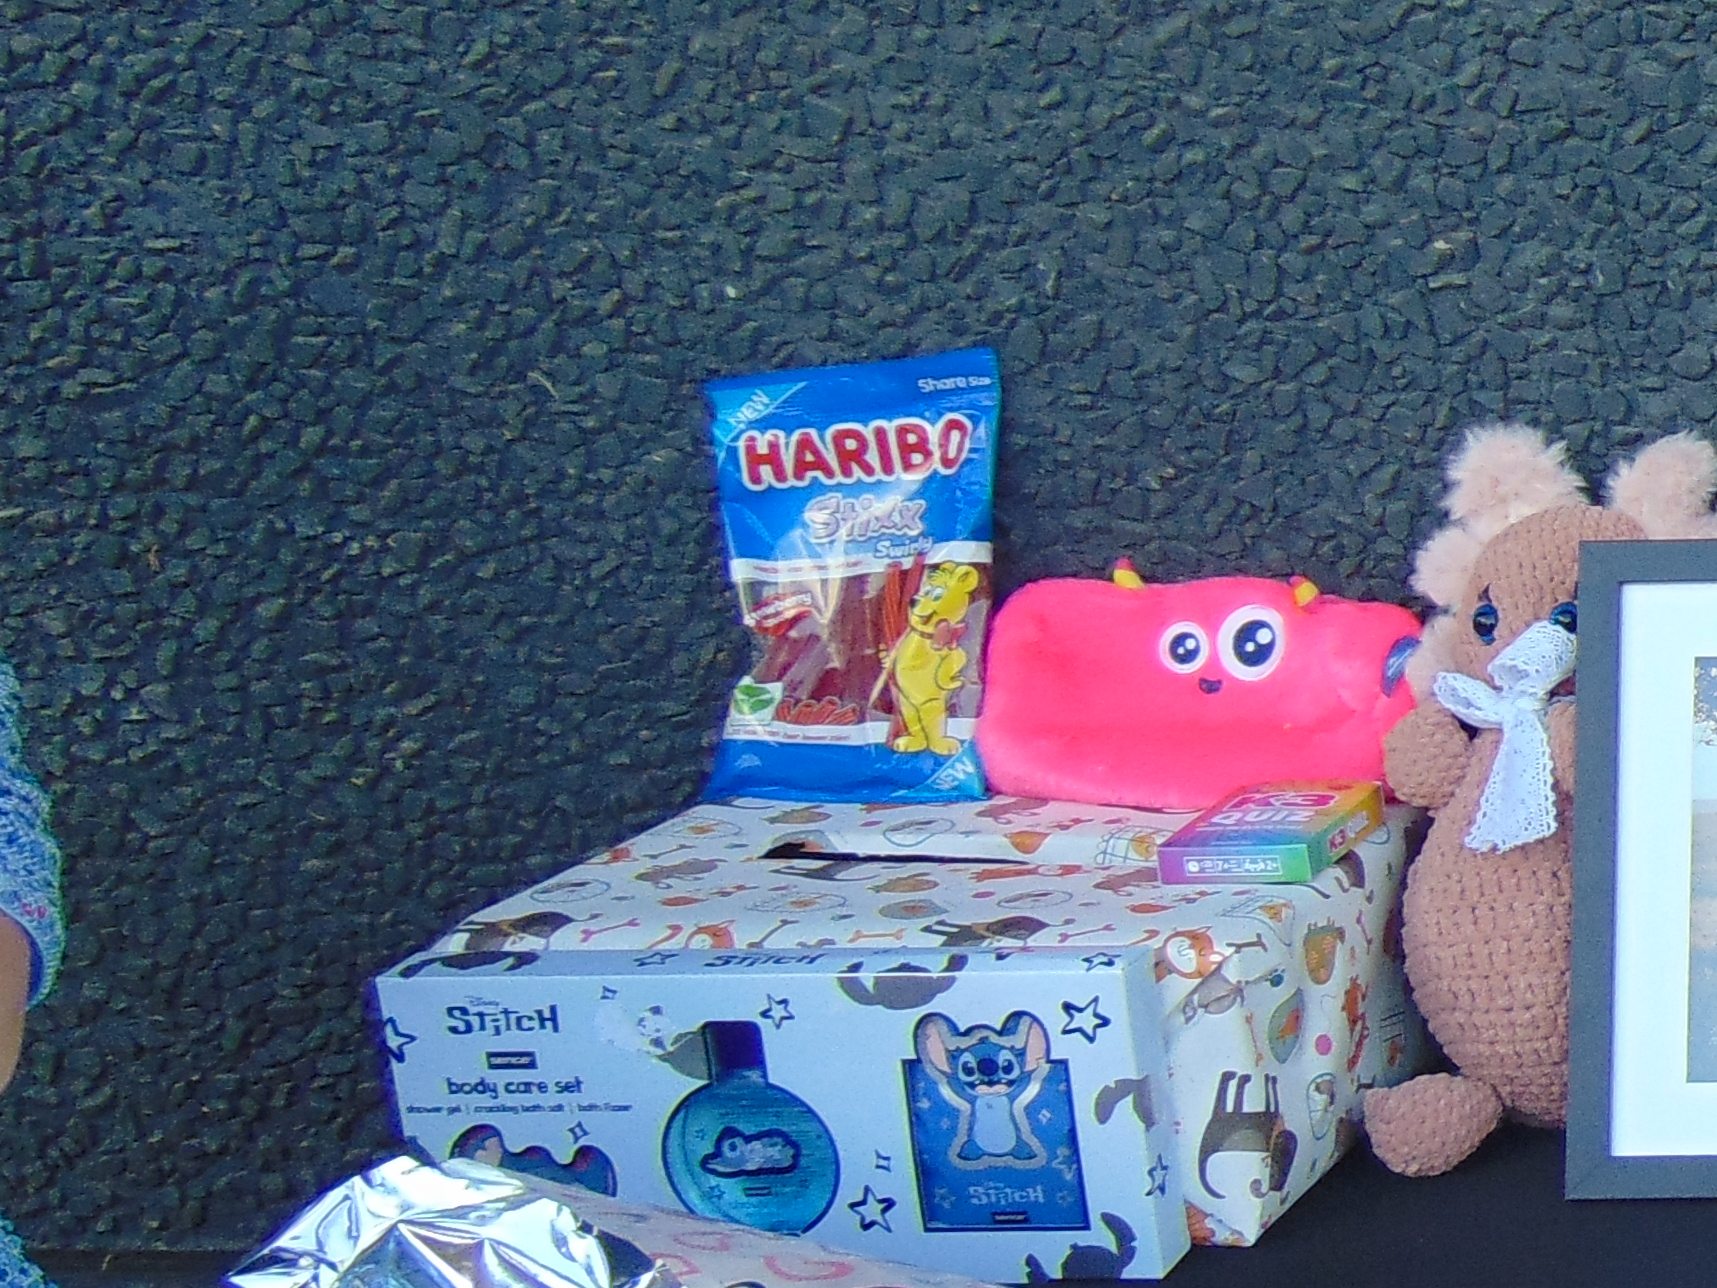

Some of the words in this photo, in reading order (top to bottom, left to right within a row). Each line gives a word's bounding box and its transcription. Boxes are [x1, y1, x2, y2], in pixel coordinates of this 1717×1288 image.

[918, 375, 967, 393] Share
[729, 389, 771, 429] NEW
[742, 414, 972, 488] HARIBO
[805, 493, 926, 543] Stixx
[934, 757, 975, 792] NEW
[1223, 791, 1341, 811] K3
[1210, 810, 1318, 825] QUIZ
[446, 1076, 499, 1099] body
[504, 1080, 549, 1095] care
[555, 1075, 585, 1095] set
